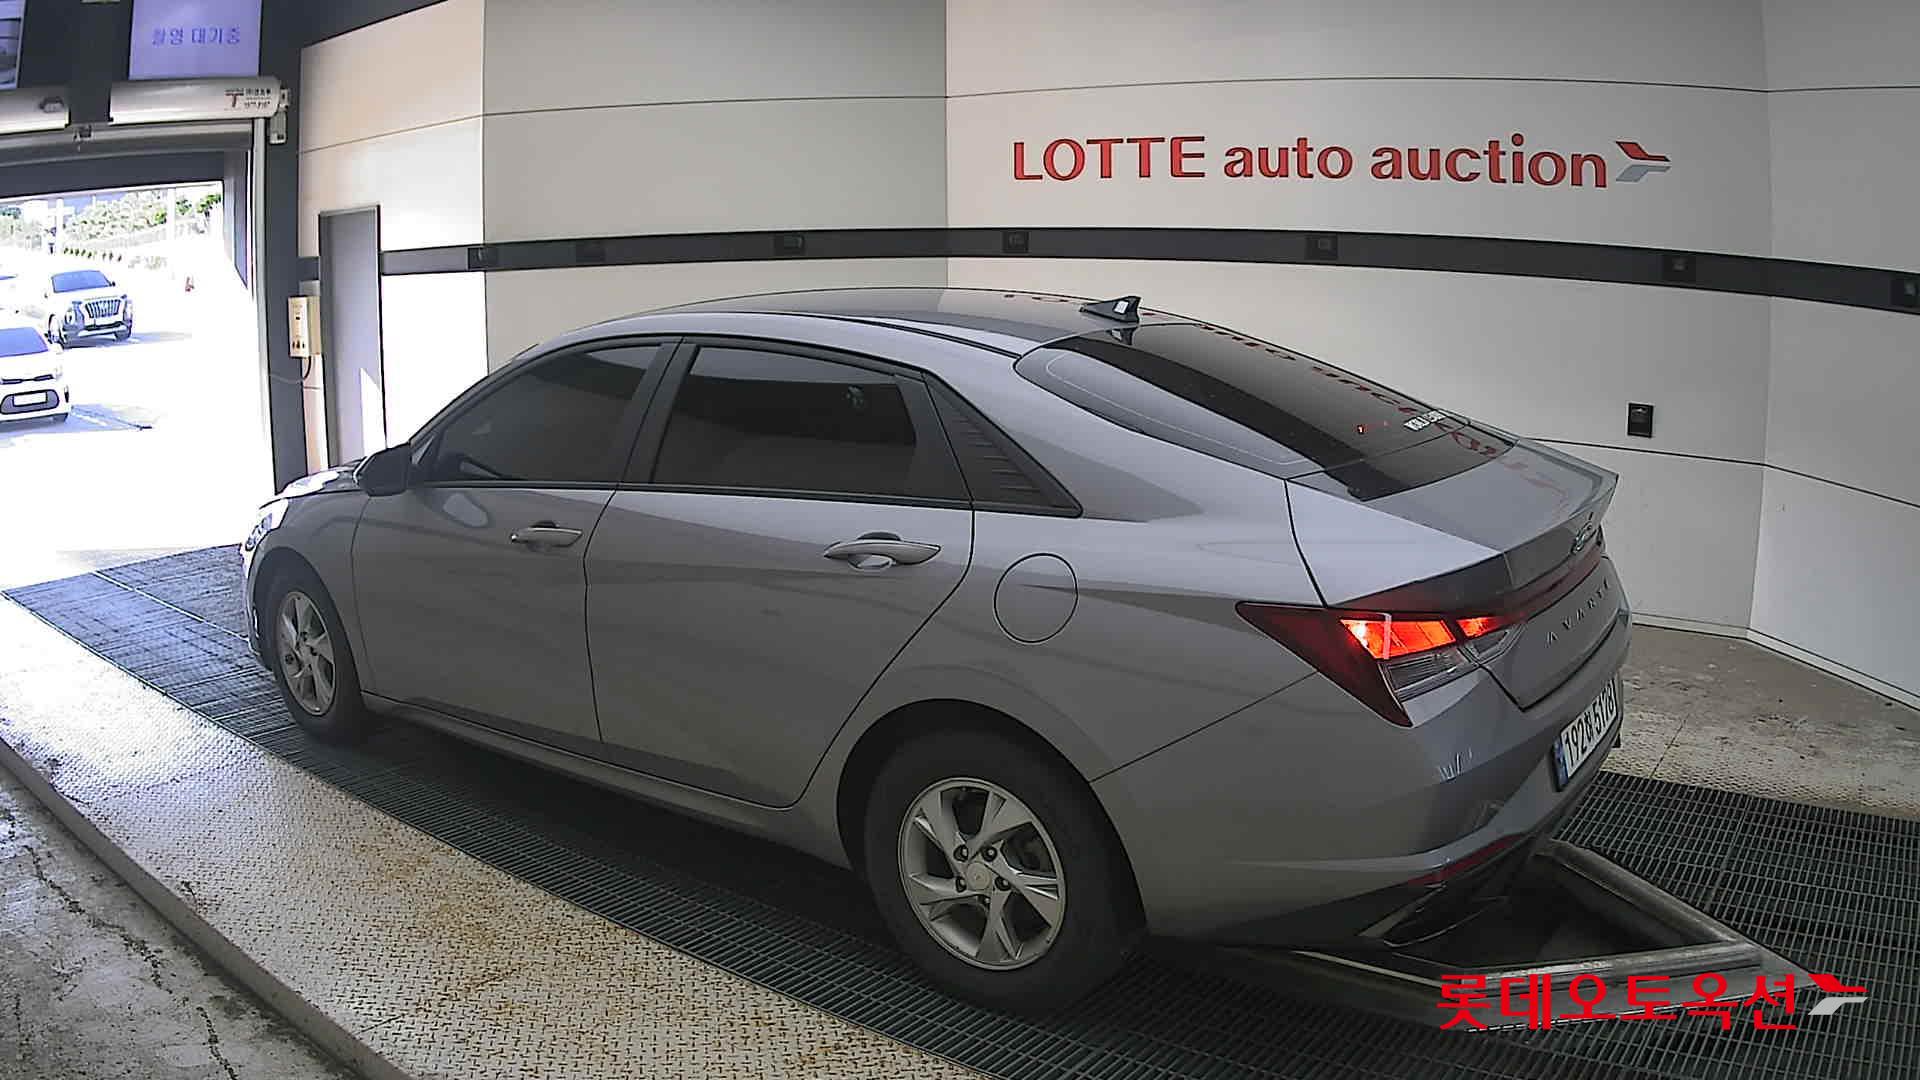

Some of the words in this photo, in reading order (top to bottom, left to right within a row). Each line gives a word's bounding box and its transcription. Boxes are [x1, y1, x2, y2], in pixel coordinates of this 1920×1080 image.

[1013, 135, 1206, 181] LOTTE
[1223, 137, 1354, 178] auto
[1370, 134, 1607, 188] auction
